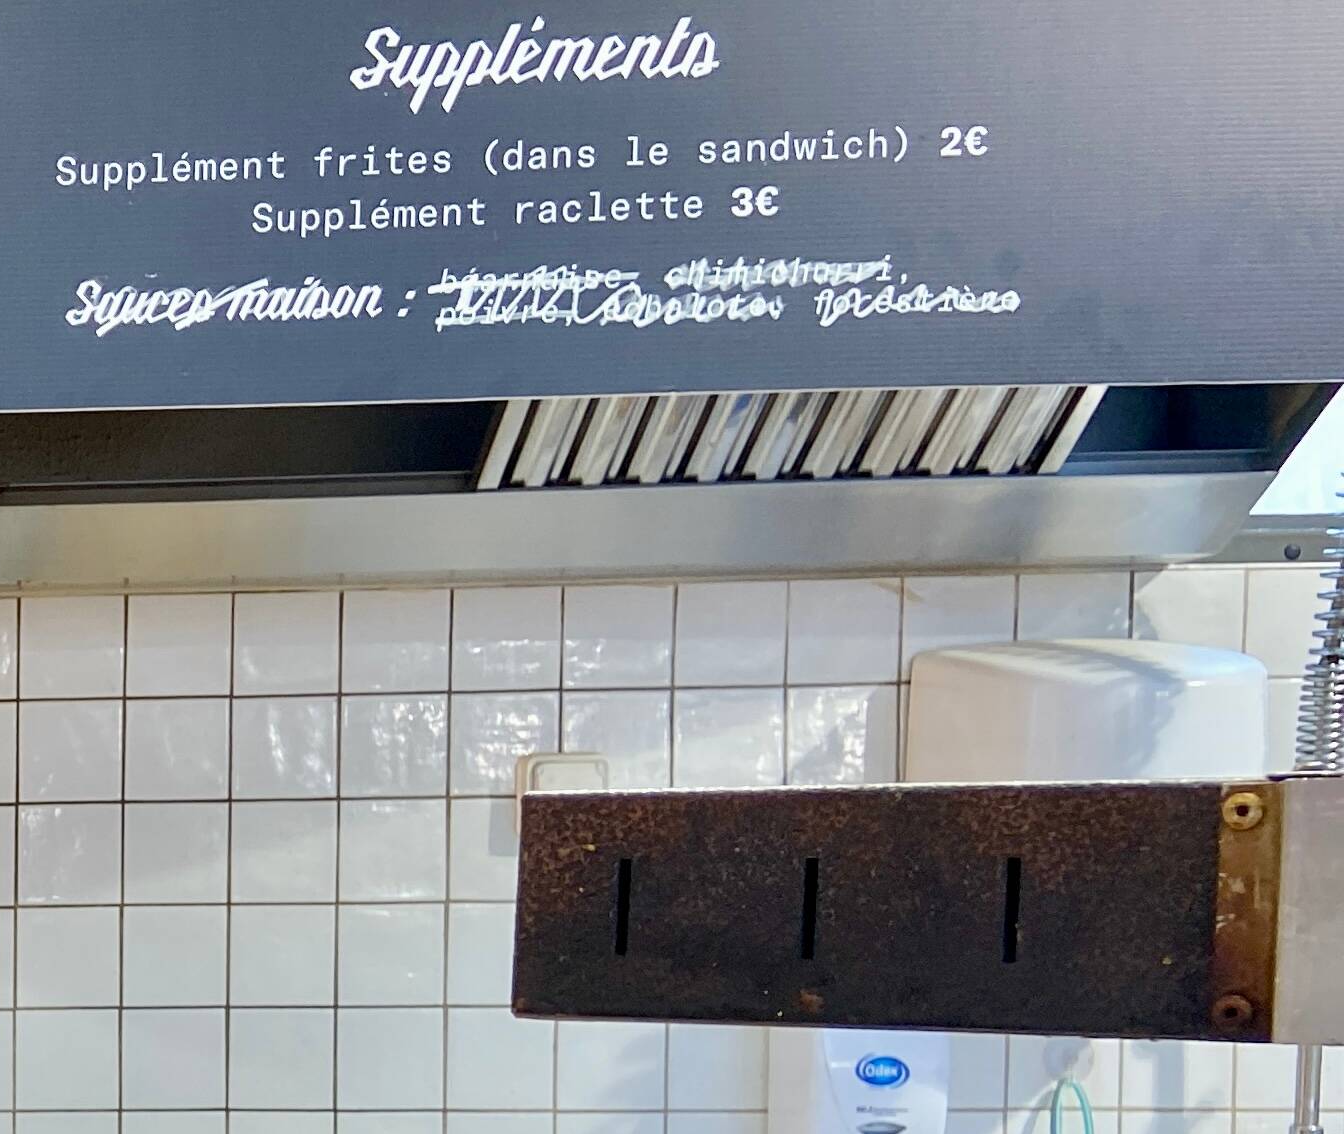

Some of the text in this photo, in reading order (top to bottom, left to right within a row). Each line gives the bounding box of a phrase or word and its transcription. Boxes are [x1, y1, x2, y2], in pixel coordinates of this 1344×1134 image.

[349, 15, 720, 115] Suppléments
[55, 125, 989, 192] Supplément frites (dans le sandwich) 2€
[252, 185, 779, 239] Supplément raclette 3€
